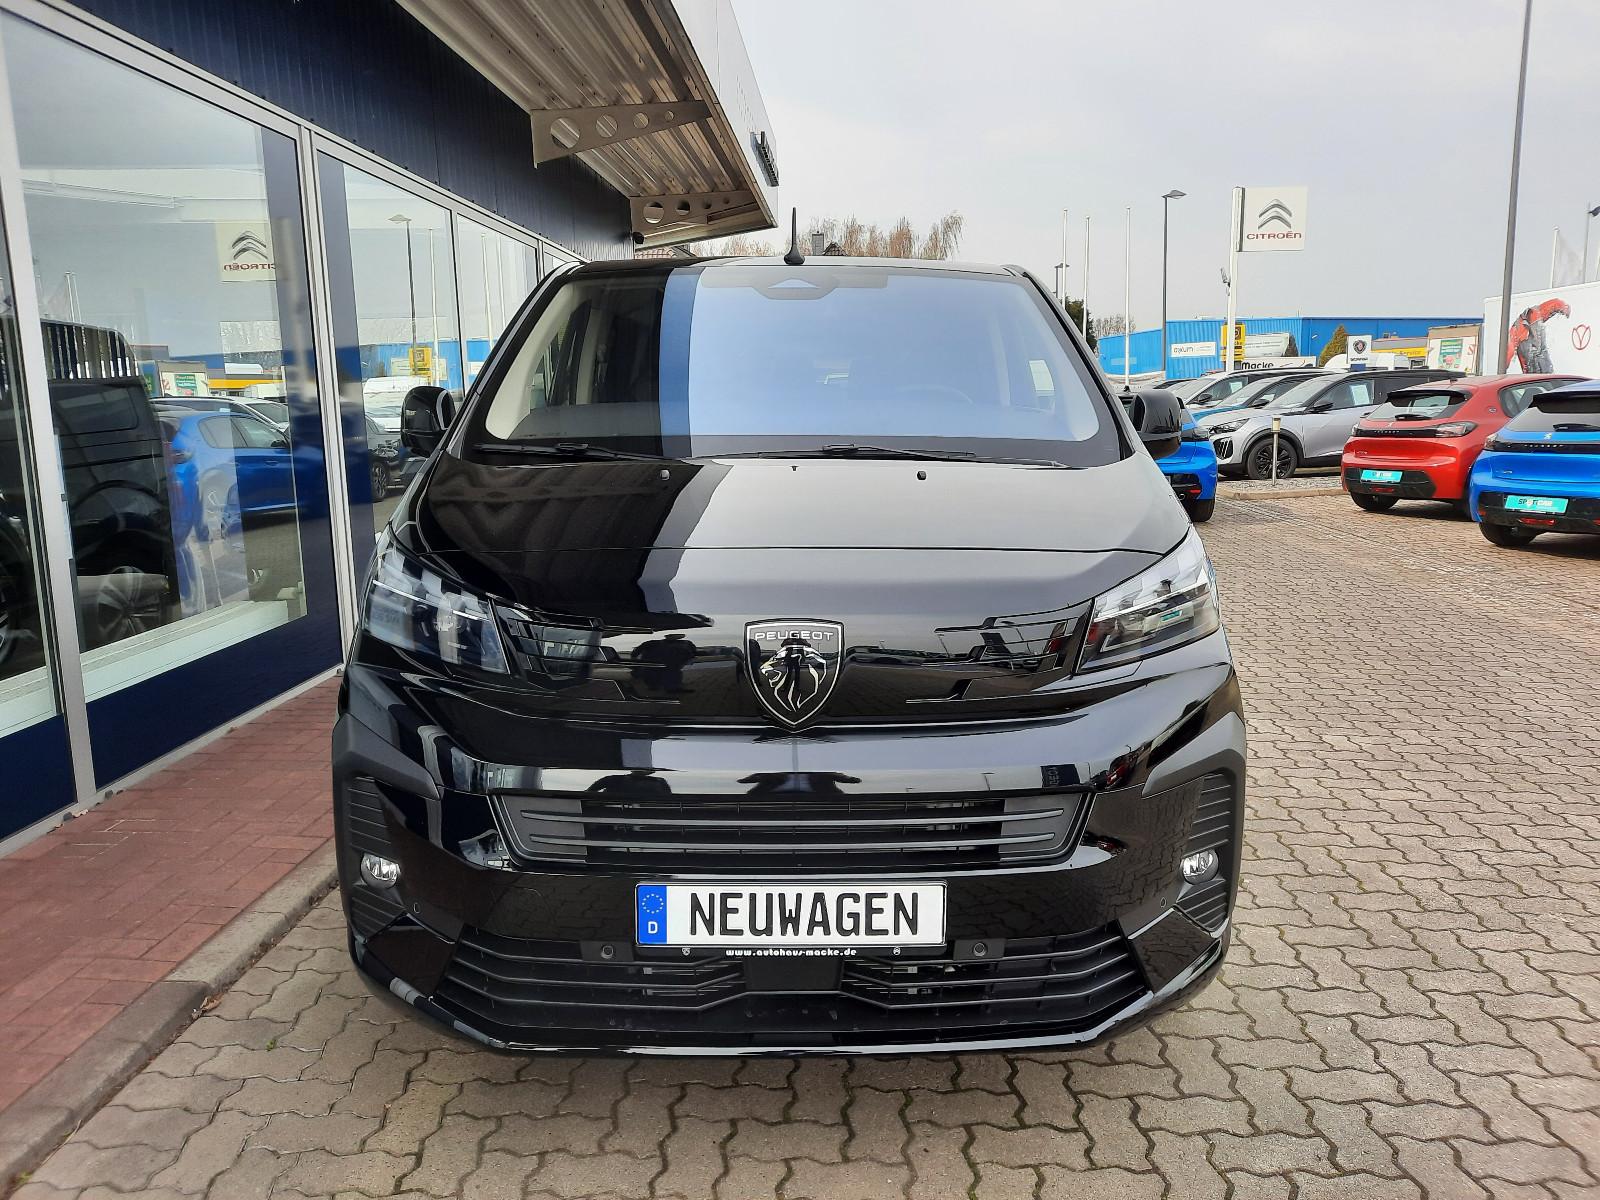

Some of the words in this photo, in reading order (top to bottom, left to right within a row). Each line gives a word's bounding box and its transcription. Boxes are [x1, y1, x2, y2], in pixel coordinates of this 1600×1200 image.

[1246, 230, 1302, 240] CITROËN
[754, 630, 834, 641] PEUGEOT
[689, 892, 919, 937] NEUWAGEN
[647, 921, 658, 934] D
[725, 948, 858, 957] www.autohaus-macke.de
